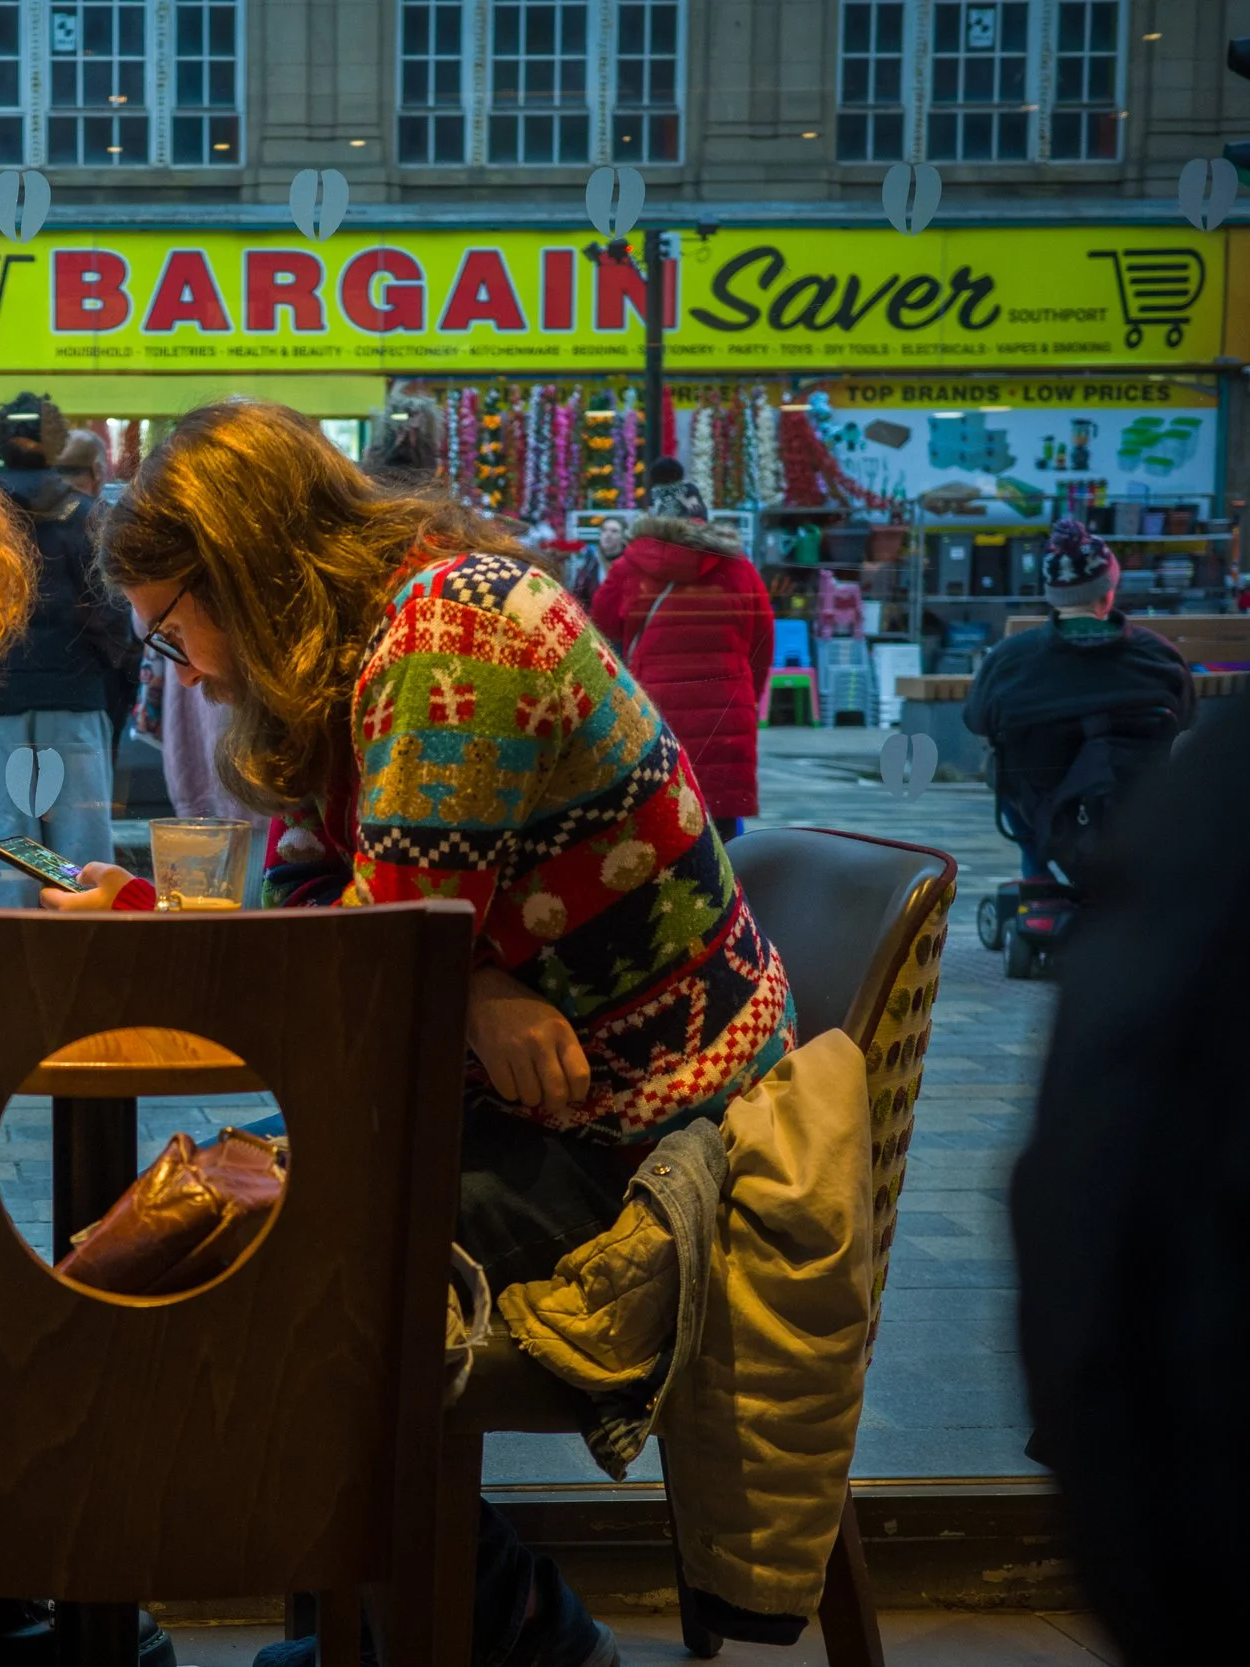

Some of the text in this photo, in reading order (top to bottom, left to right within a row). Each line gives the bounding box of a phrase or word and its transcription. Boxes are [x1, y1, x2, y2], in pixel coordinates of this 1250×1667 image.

[51, 246, 1001, 333] BARGAIN Saver
[1007, 307, 1110, 324] SOUTHPORT
[55, 346, 134, 358] HOUSEHOLD
[145, 346, 216, 357] TOILETRIES
[227, 346, 277, 357] HEALTH
[292, 346, 342, 357] BEAUTY
[354, 345, 459, 357] CONFECTIONERY
[469, 345, 561, 356] KITCHENWARE
[572, 344, 628, 356] BEDDING
[727, 344, 768, 355] PARTY
[780, 343, 813, 355] TOYS
[824, 343, 844, 355] DIY
[849, 343, 889, 355] TOOLS
[901, 343, 986, 355] ELECTRICALS
[996, 342, 1038, 354] VAPES
[1053, 342, 1113, 354] SMOKING
[846, 384, 1171, 402] TOP BRANDS LOW PRICES
